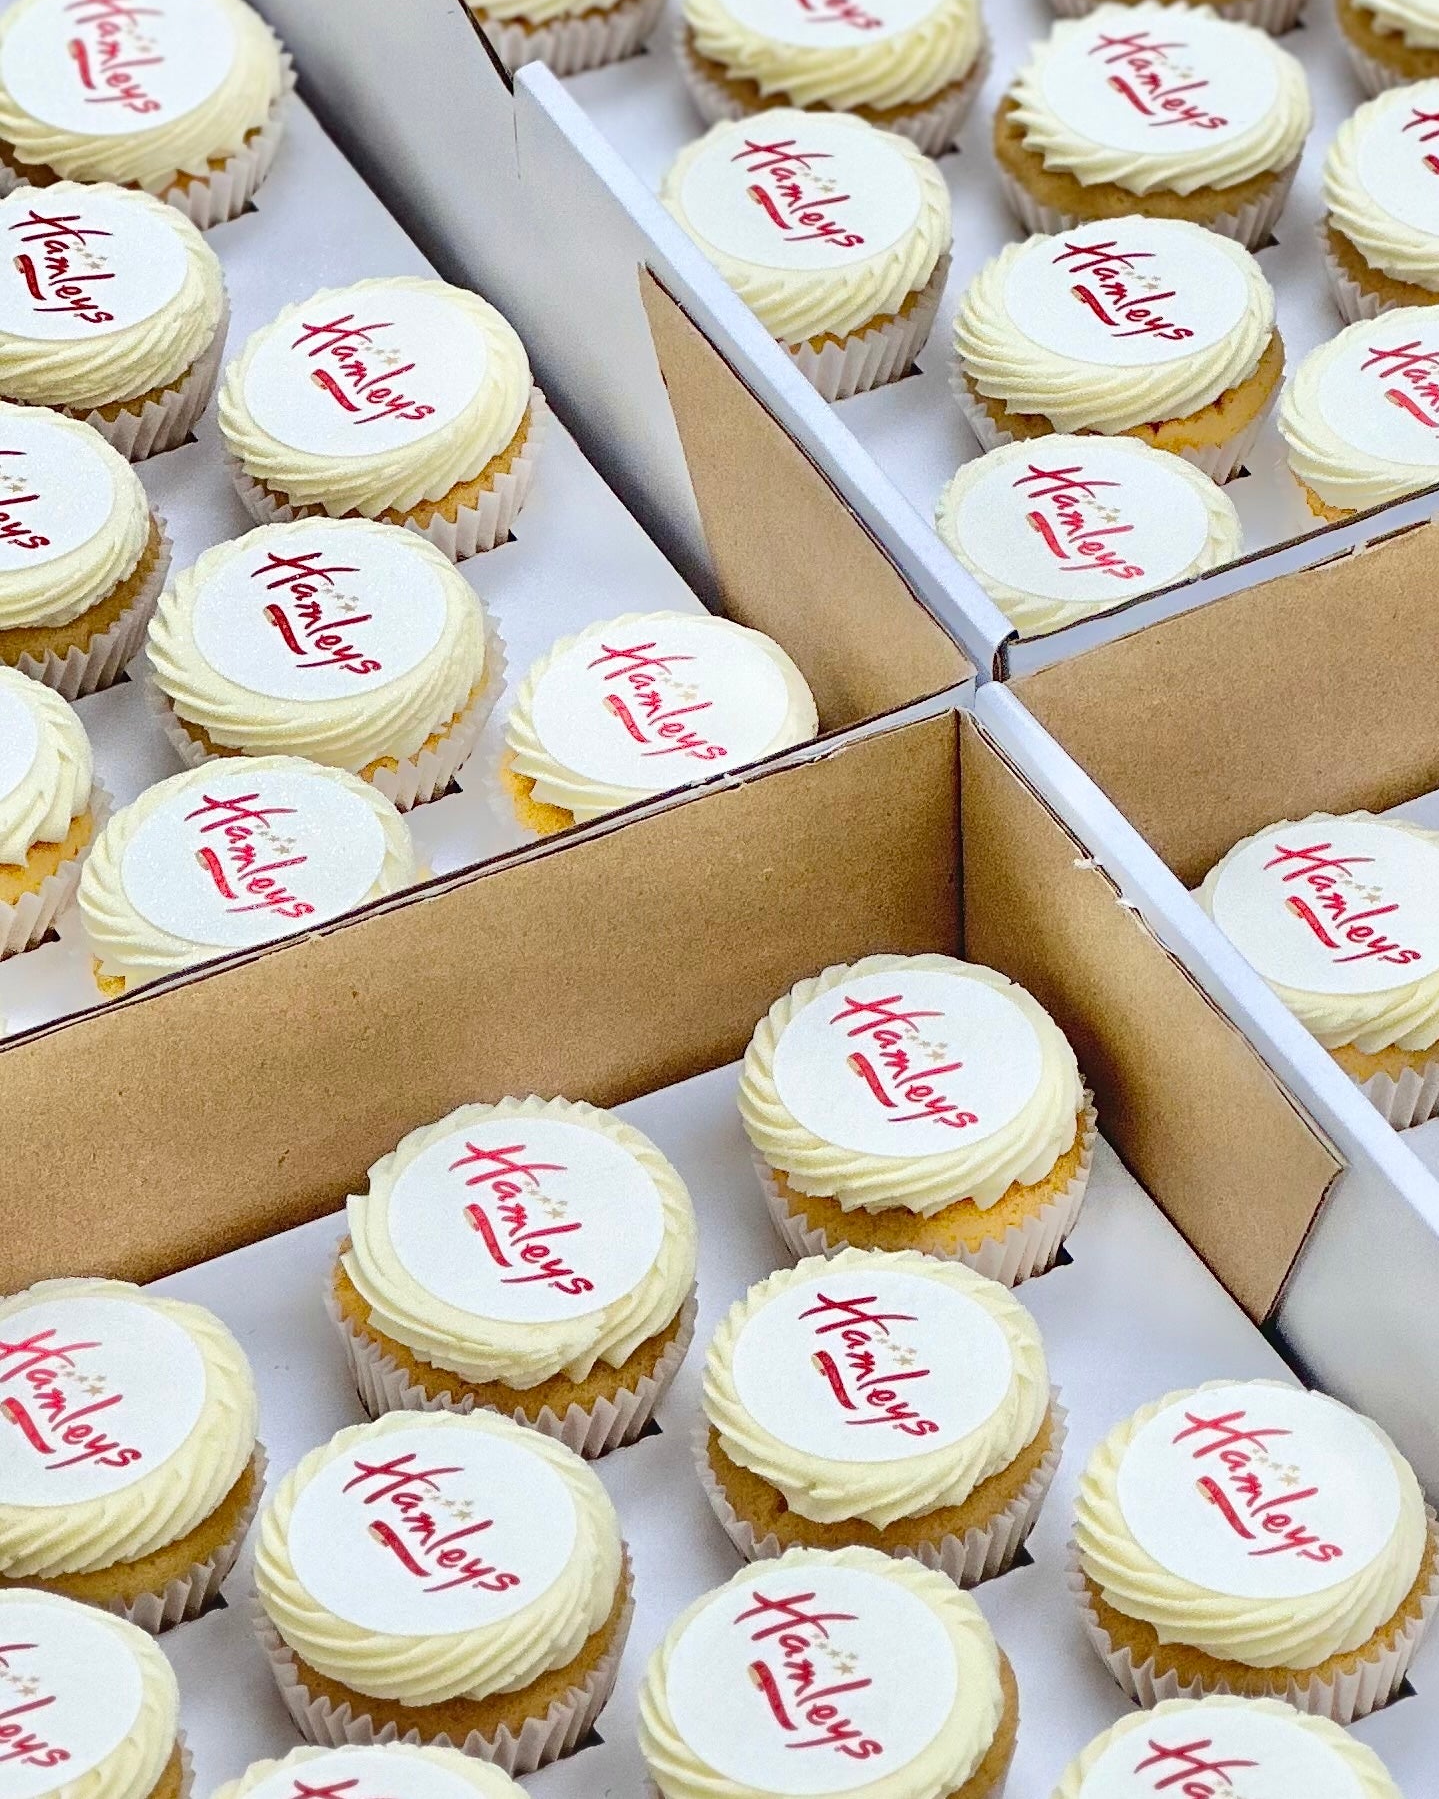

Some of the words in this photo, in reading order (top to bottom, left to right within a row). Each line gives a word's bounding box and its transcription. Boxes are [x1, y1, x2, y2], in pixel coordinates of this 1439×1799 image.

[1096, 33, 1228, 130] Hamleys
[736, 140, 865, 249] Hamleys
[14, 210, 115, 325] Hamleys
[1054, 241, 1194, 342] Hamleys
[293, 314, 436, 424] Hamleys
[1014, 464, 1145, 580] Hamleys
[254, 552, 382, 676] Hamleys
[591, 641, 728, 761] Hamleys
[187, 792, 315, 919] Hamleys
[1264, 842, 1422, 966] Hamleys
[831, 994, 980, 1130] Hamleys
[450, 1142, 596, 1297] Hamleys
[0, 1328, 143, 1470] Hamleys
[800, 1292, 940, 1438] Hamleys
[343, 1453, 521, 1593] Hamleys
[1172, 1410, 1344, 1564] Hamleys
[735, 1591, 884, 1761] Hamleys
